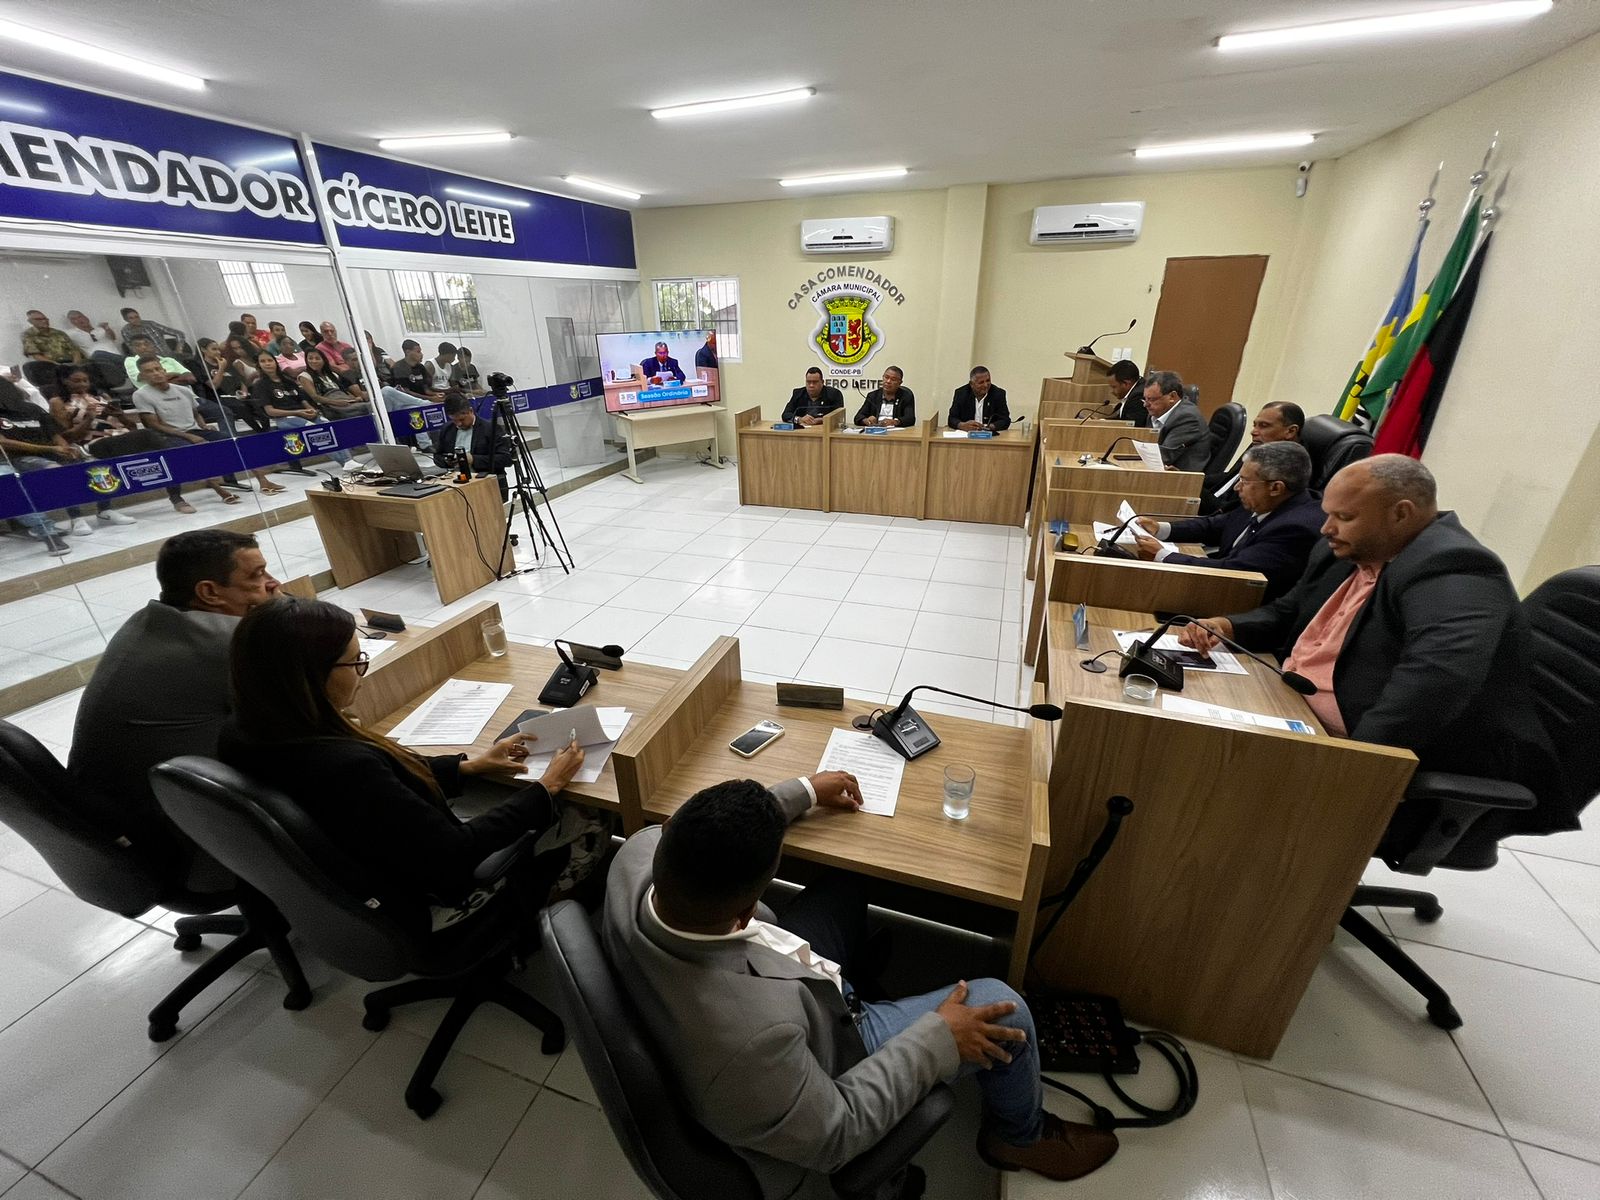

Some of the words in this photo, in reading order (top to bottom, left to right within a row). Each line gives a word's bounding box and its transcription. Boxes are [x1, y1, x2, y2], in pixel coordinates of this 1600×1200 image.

[327, 178, 442, 230] CÍCERO
[450, 205, 512, 239] LEITE
[788, 279, 817, 310] CASA
[817, 265, 905, 306] COMENDADOR
[811, 284, 842, 303] CÂMARA
[843, 283, 881, 302] MUNICIPAL
[641, 392, 661, 400] Sessão
[662, 390, 689, 398] Ordinária
